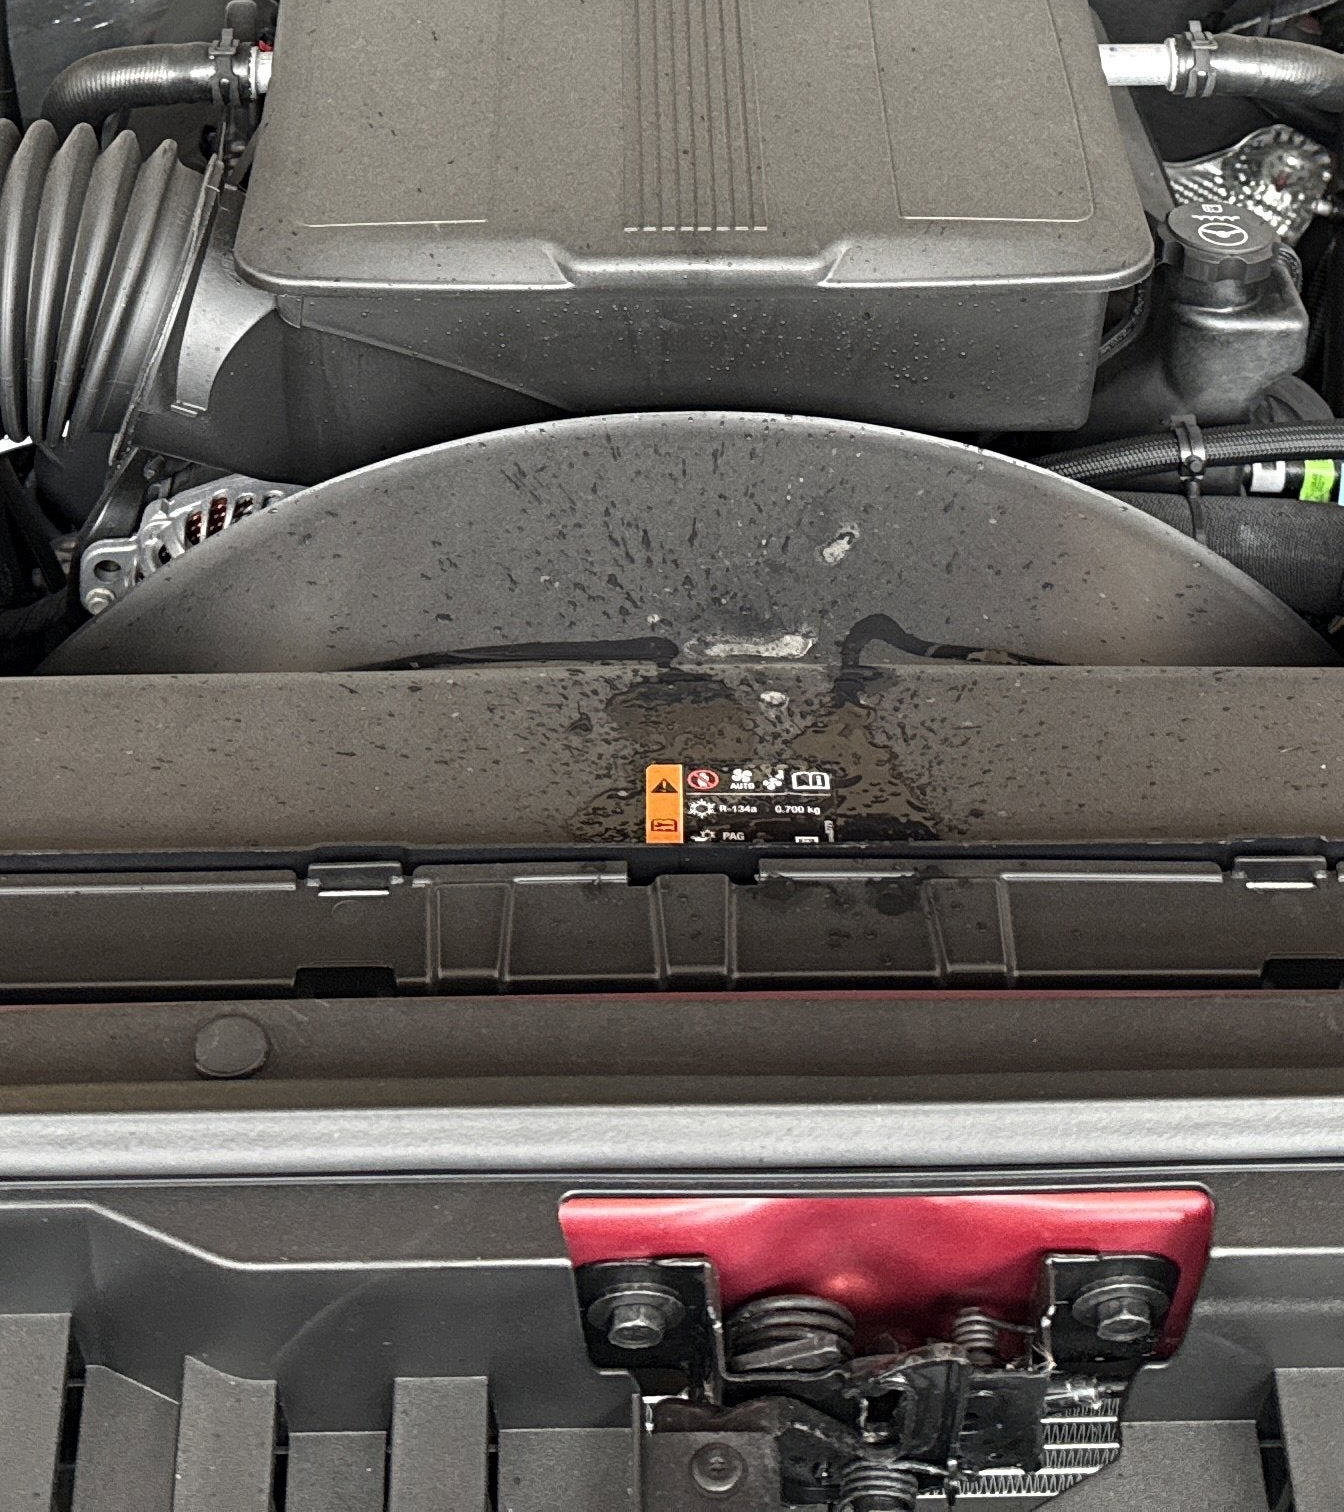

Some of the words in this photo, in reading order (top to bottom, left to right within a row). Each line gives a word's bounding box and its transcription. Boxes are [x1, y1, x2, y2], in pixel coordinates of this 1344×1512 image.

[729, 782, 755, 790] AUTO
[719, 805, 758, 813] R-134a
[774, 805, 805, 813] 0.700
[807, 805, 821, 815] kg
[722, 831, 745, 841] PAG
